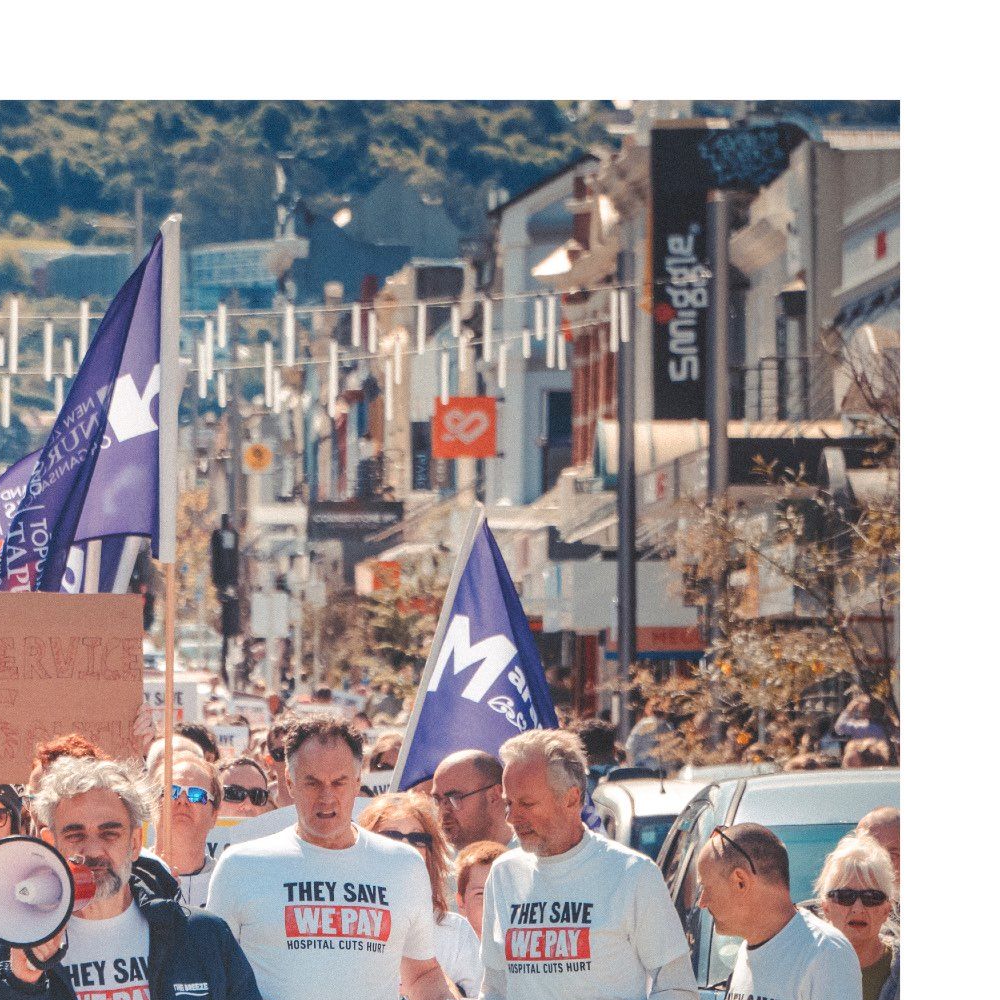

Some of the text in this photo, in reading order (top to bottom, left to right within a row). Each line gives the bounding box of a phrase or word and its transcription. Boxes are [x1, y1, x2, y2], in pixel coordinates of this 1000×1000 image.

[282, 881, 390, 907] THEY SAVE
[293, 907, 384, 938] WE PAY
[510, 901, 594, 925] THEY SAVE
[286, 939, 386, 954] HOSPITAL CUTS HURT
[511, 929, 582, 958] WE PAY
[66, 956, 150, 988] HEY SAV
[507, 960, 592, 974] HOSPITAL CUTS HURT
